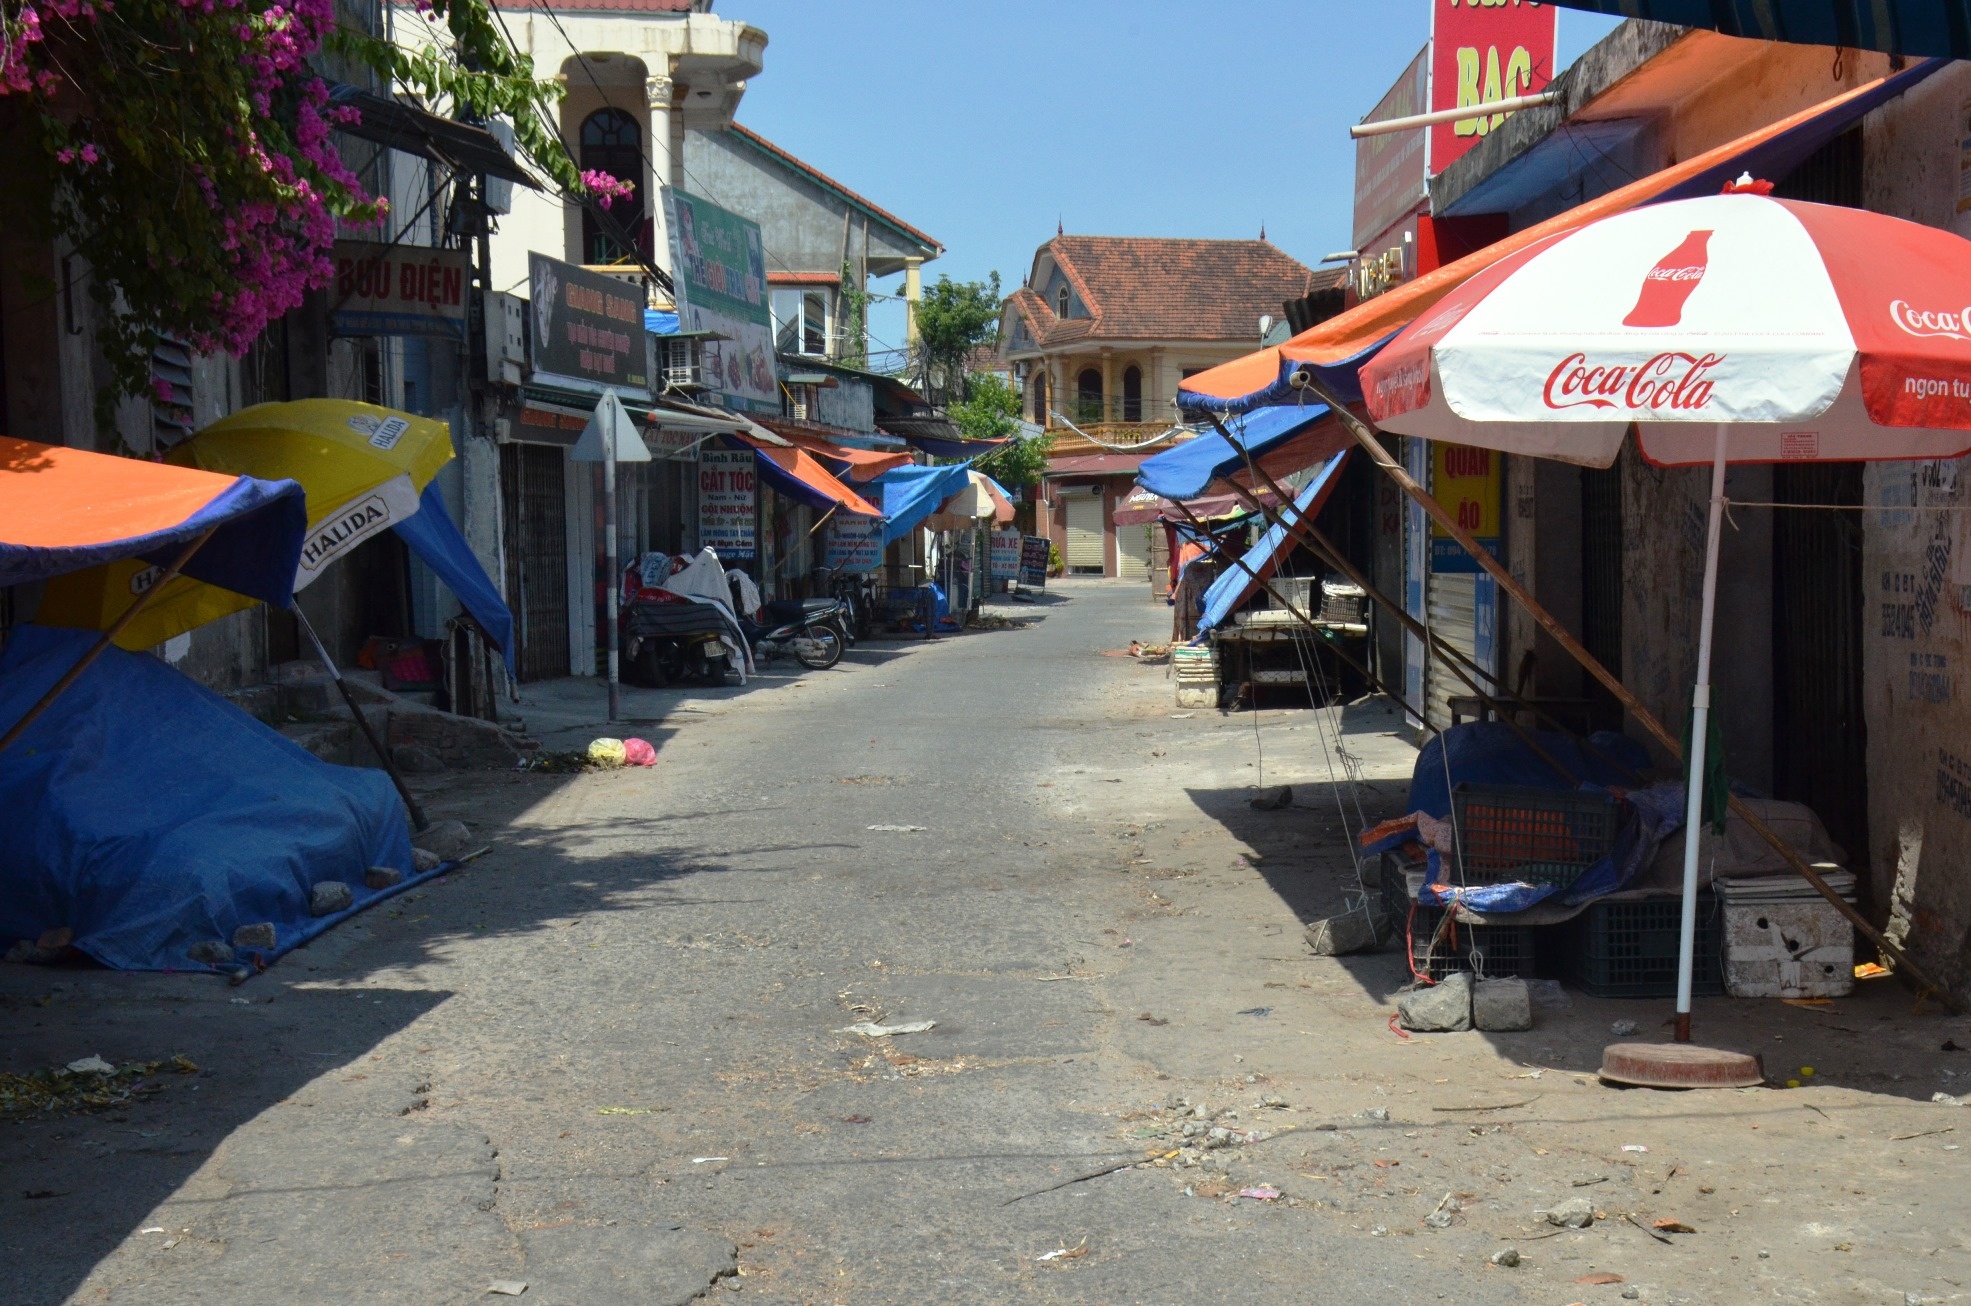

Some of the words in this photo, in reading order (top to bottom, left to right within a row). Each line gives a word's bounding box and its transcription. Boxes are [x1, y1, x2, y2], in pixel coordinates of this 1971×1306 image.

[399, 257, 461, 310] ĐIỆN
[1648, 266, 1704, 281] Coca-Cola
[565, 282, 604, 315] GIANG
[605, 293, 637, 324] SANG
[1543, 352, 1728, 410] Coca-Cola
[1905, 376, 1949, 400] ngon
[373, 420, 405, 448] HALIDA
[303, 505, 384, 563] HALIDA
[1008, 537, 1018, 549] XE
